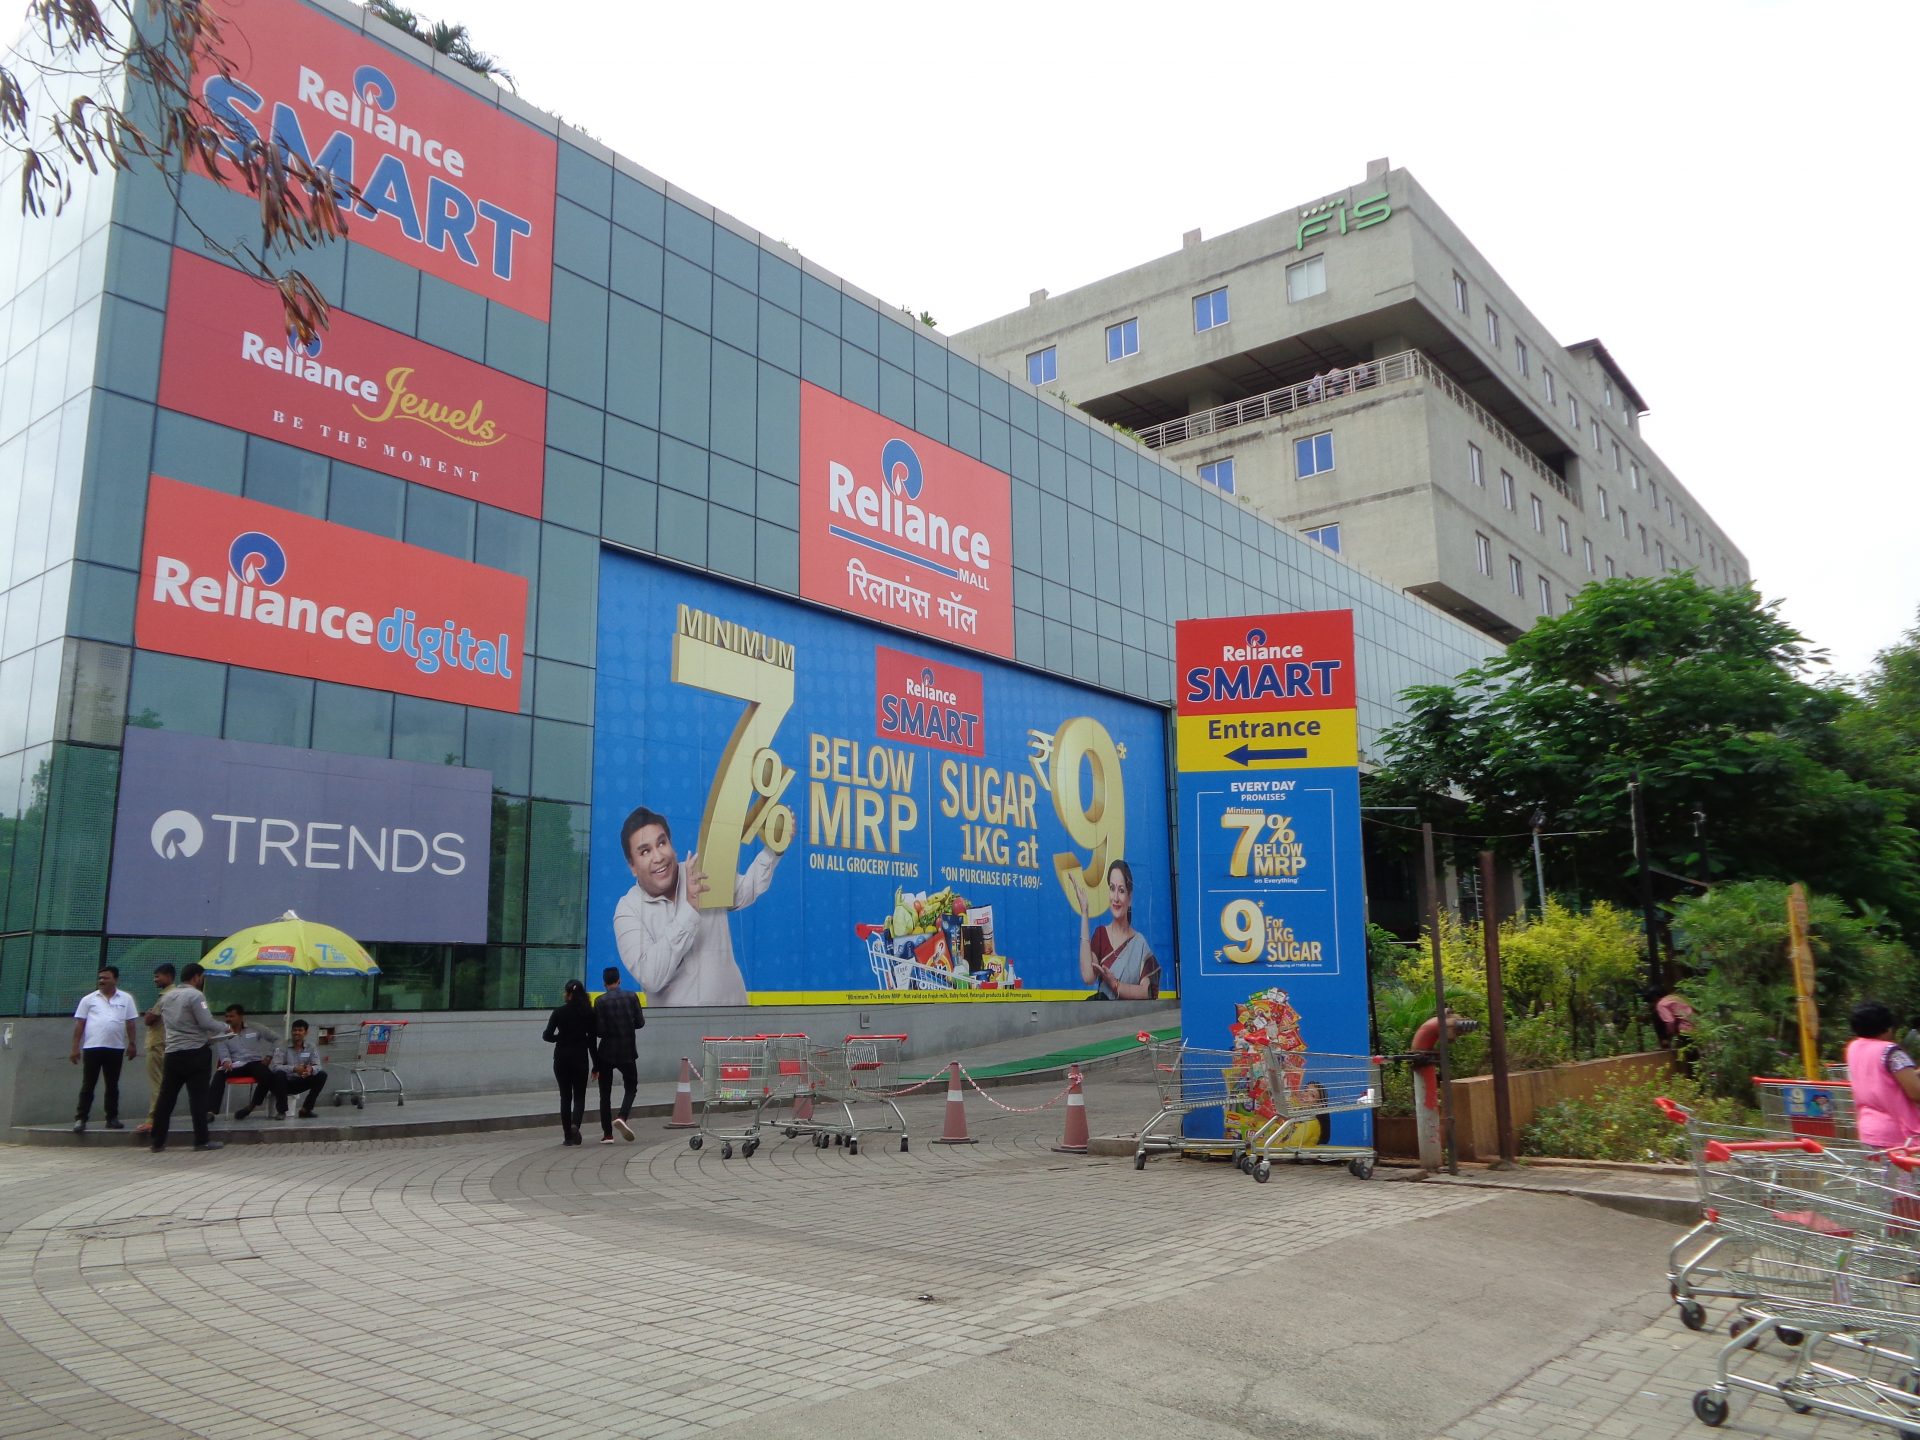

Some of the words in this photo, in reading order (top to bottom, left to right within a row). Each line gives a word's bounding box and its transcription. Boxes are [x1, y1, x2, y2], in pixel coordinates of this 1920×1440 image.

[298, 66, 464, 177] Reliance
[202, 74, 532, 281] SMART
[241, 331, 378, 403] Reliance
[352, 367, 506, 447] Jewels
[273, 410, 303, 430] BE
[320, 424, 367, 449] THE
[383, 443, 480, 482] MOMENT
[829, 460, 990, 570] Reliance
[847, 557, 930, 619] रिलायंस
[937, 592, 978, 635] मॉल
[959, 568, 990, 591] MALL
[153, 556, 373, 645] Reliance
[377, 608, 512, 680] digital
[677, 602, 796, 670] MINIMUM
[1223, 645, 1304, 662] Reliance
[906, 678, 957, 706] Reliance
[1187, 660, 1342, 703] SMART
[882, 693, 979, 748] SMART
[1208, 719, 1321, 740] Entrance
[810, 732, 915, 793] BELOW
[941, 759, 1038, 830] SUGAR
[1230, 781, 1270, 793] EVERY
[1271, 780, 1297, 792] DAY
[1241, 792, 1286, 802] PROMISES
[810, 781, 918, 854] MRP
[1226, 806, 1264, 815] Minimum
[211, 813, 466, 876] TRENDS
[810, 852, 825, 870] ON
[827, 854, 845, 872] ALL
[847, 857, 890, 876] GROCERY
[891, 861, 919, 878] ITEMS
[961, 823, 1009, 865] 1KG
[1017, 834, 1039, 869] at
[1254, 843, 1304, 858] BELOW
[959, 868, 1001, 887] PURCHASE
[1002, 872, 1011, 887] OF
[1254, 857, 1307, 876] MRP
[1266, 916, 1285, 928] For
[1266, 928, 1295, 942] 1KG
[1267, 941, 1323, 962] SUGAR
